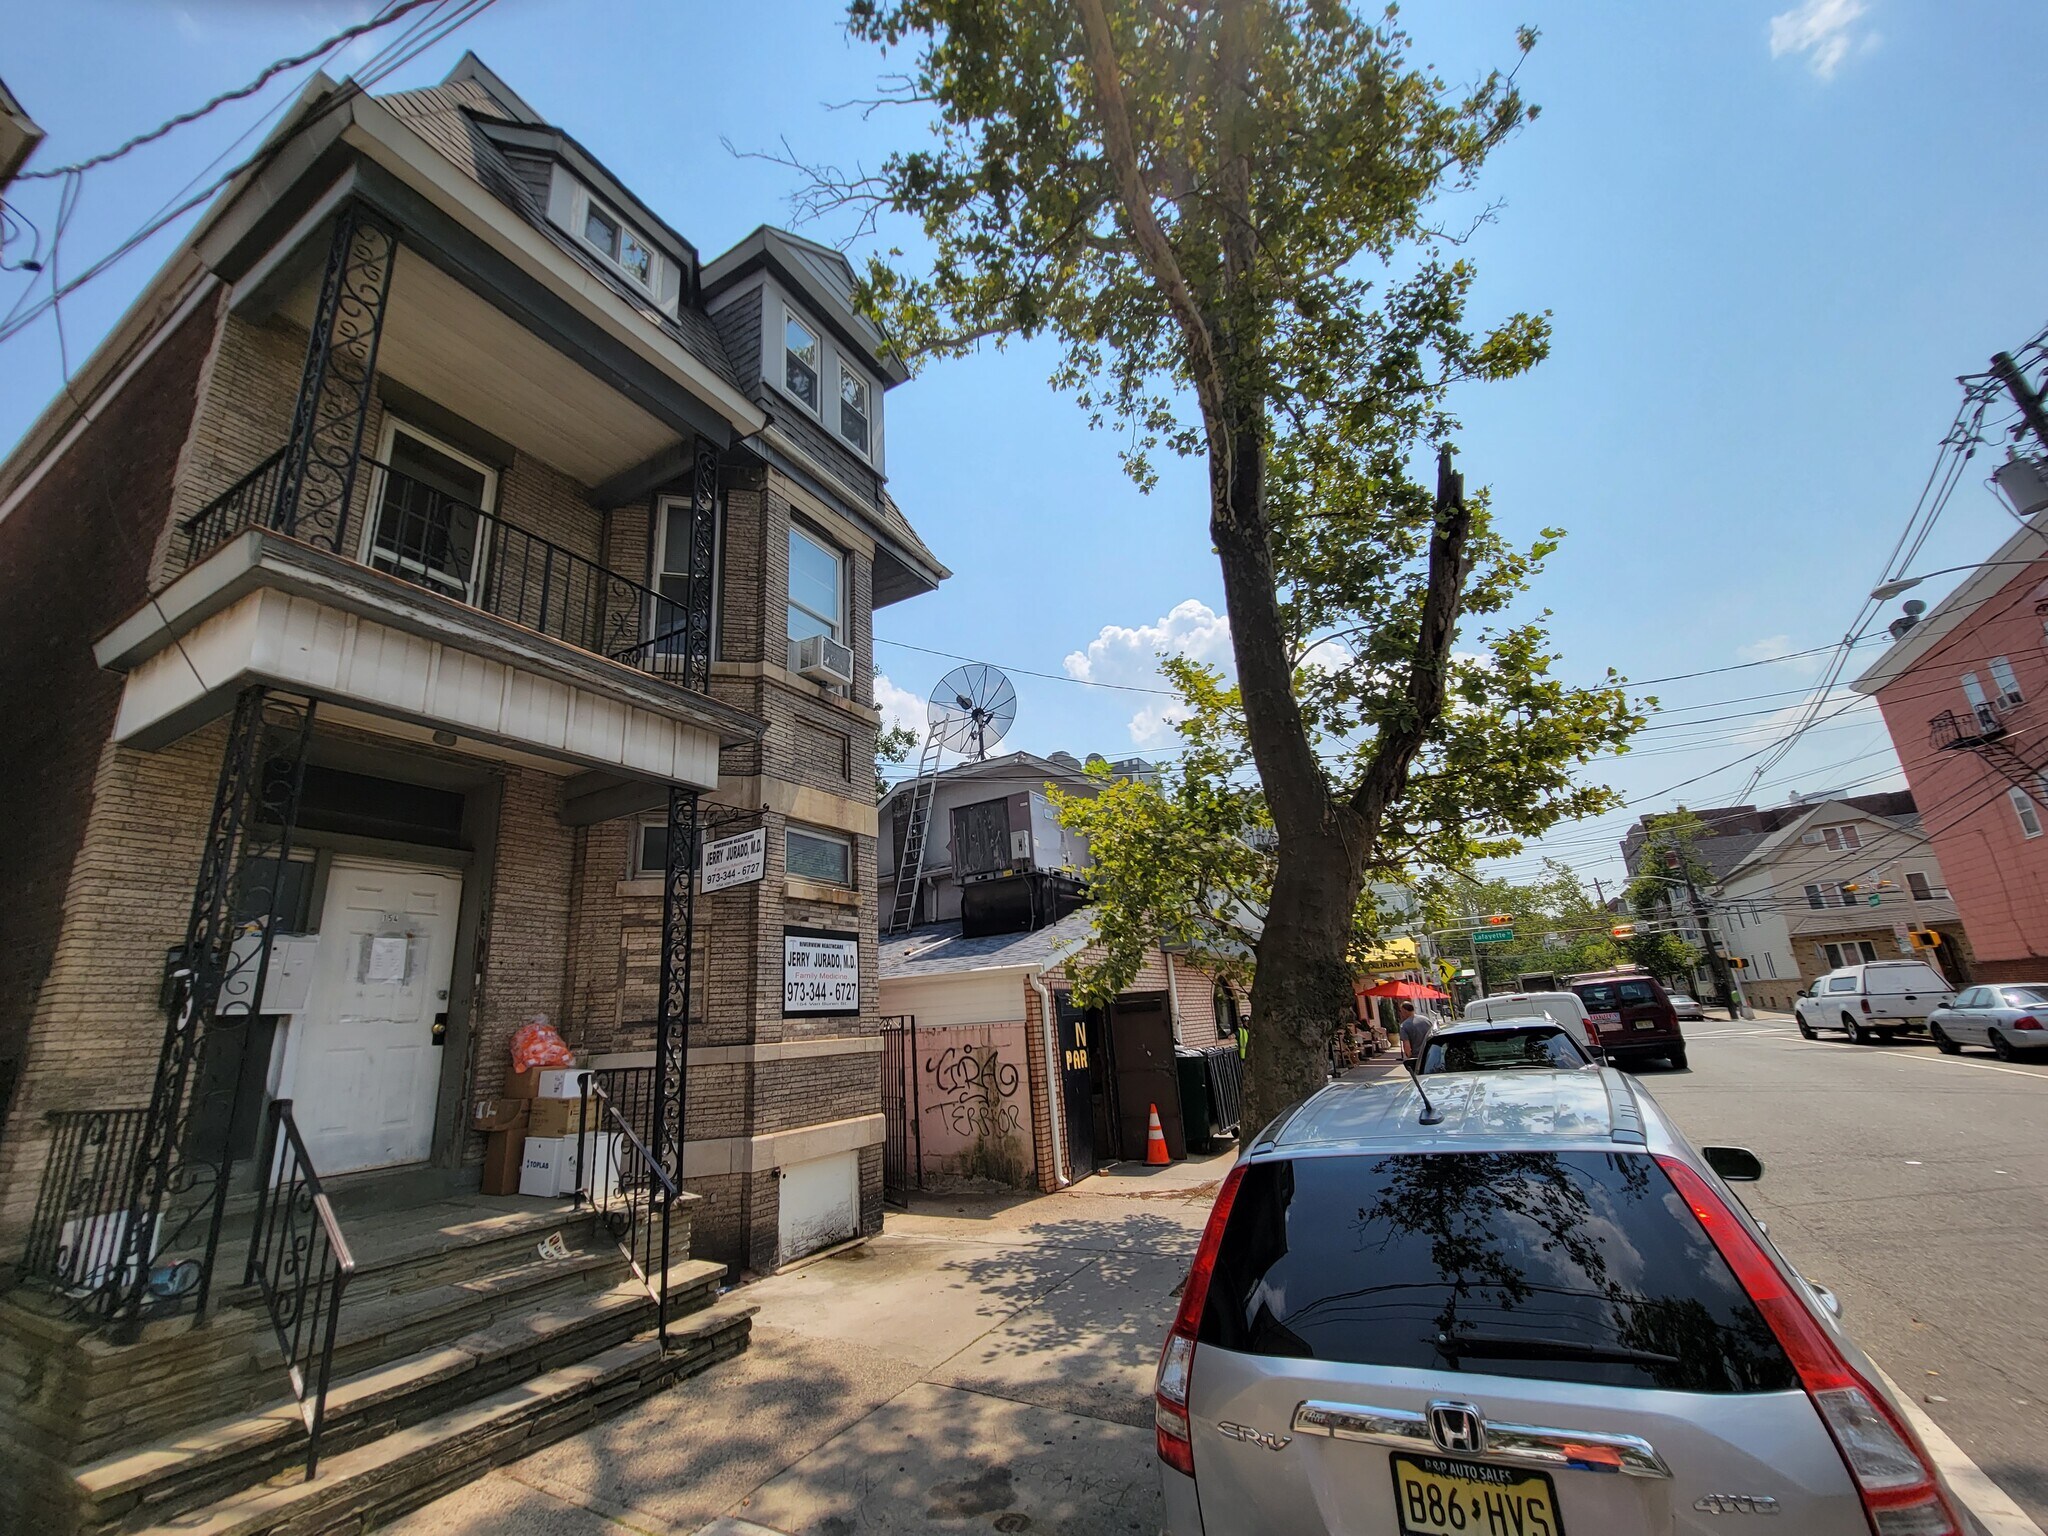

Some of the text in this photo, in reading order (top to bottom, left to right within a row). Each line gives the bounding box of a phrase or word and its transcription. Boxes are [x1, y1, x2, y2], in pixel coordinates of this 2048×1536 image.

[706, 839, 762, 866] JERRY JURADO, M.D.
[707, 869, 735, 885] 973-344
[742, 862, 760, 875] 6727
[383, 914, 399, 922] 154
[799, 941, 821, 949] RIVERVIEW
[1473, 932, 1506, 941] Lafayette
[787, 951, 857, 971] JERRY JURADO, M.D.
[795, 971, 818, 980] Family
[787, 982, 826, 1002] 973-344
[835, 982, 857, 1001] 6727
[1074, 1021, 1087, 1048] N
[1065, 1049, 1088, 1071] PAR
[530, 1160, 549, 1169] TOPLAB
[1217, 1421, 1292, 1451] CR-V
[1449, 1461, 1478, 1479] AUTO
[1479, 1466, 1514, 1484] SALES
[1405, 1480, 1550, 1536] B86 HVS
[1693, 1493, 1781, 1515] 4WD
